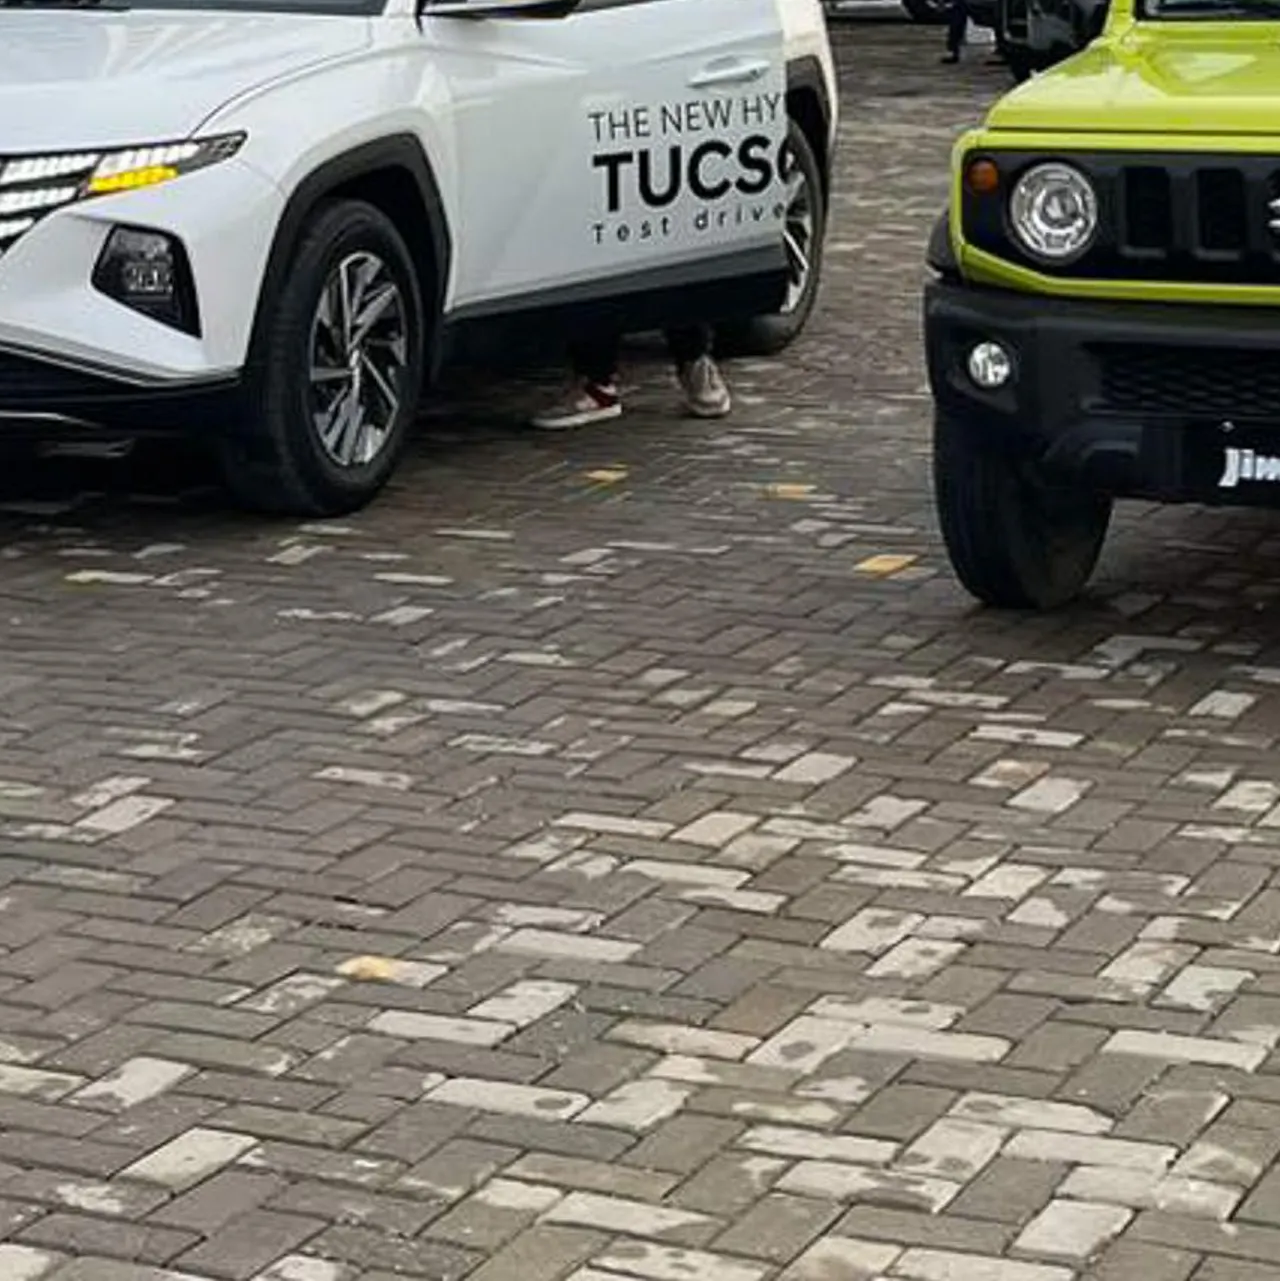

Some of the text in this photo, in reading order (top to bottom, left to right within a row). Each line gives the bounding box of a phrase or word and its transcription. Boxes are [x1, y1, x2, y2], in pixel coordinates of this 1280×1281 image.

[588, 107, 651, 142] THE
[661, 100, 732, 134] NEW
[591, 202, 785, 244] Test drive
